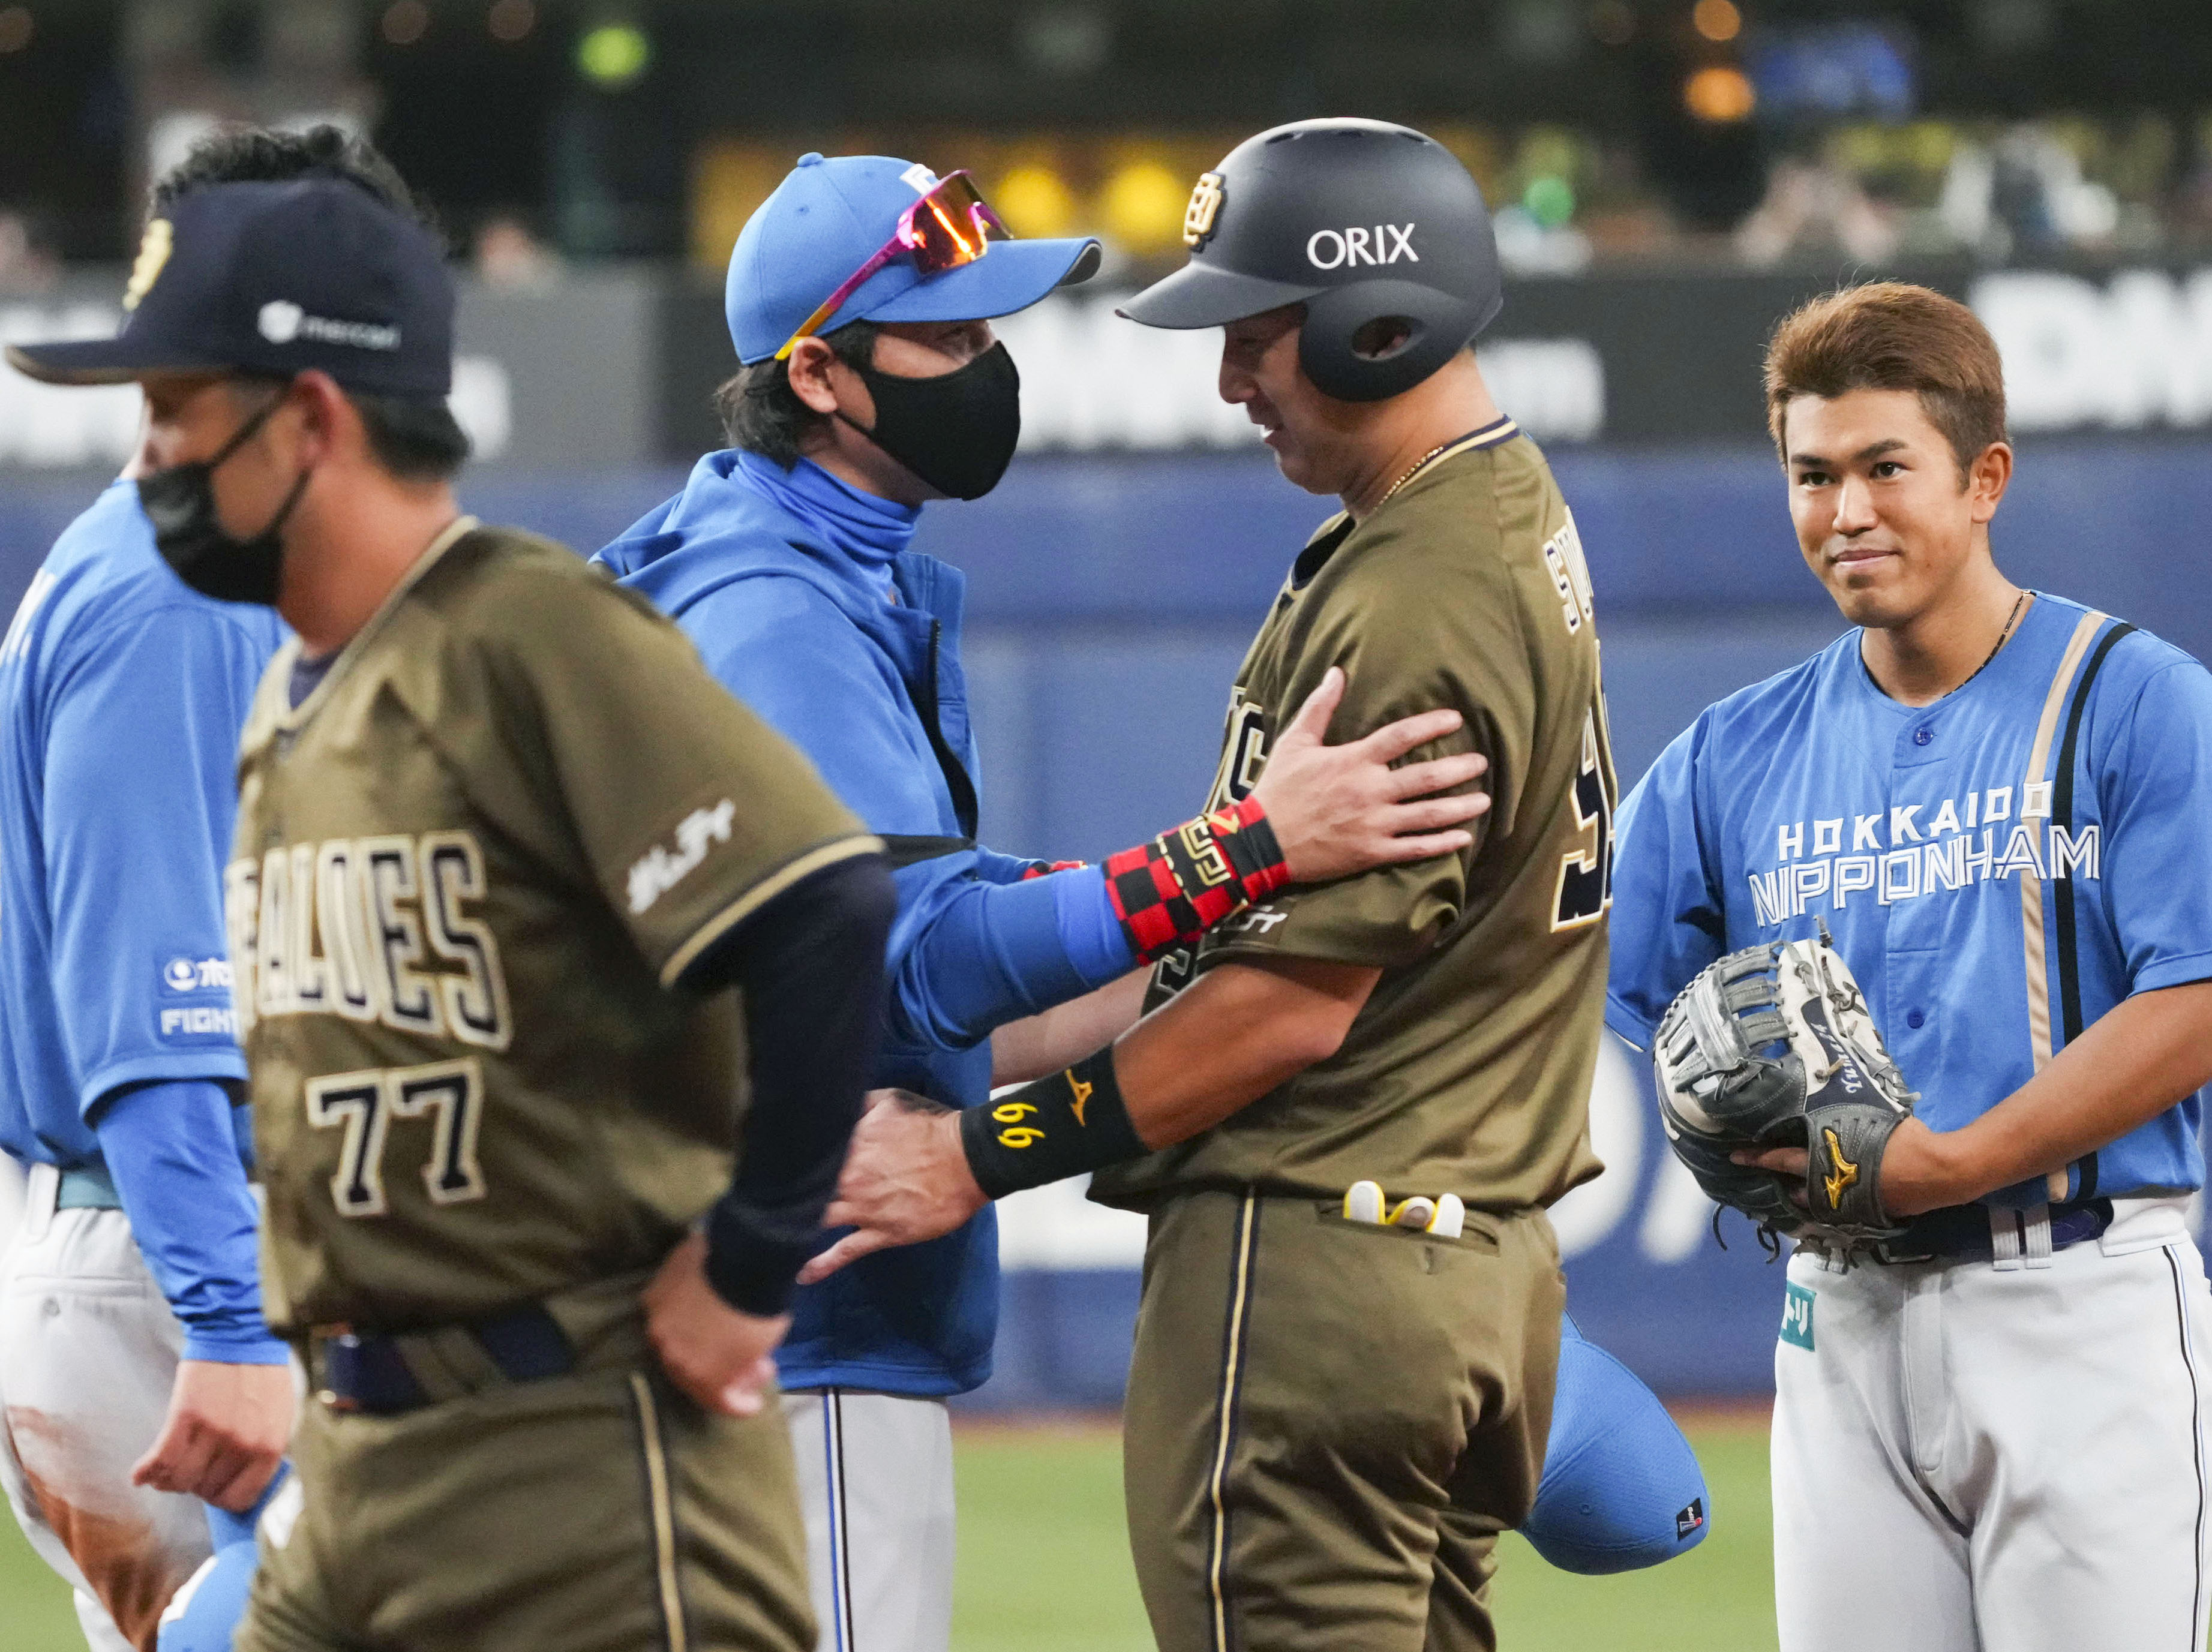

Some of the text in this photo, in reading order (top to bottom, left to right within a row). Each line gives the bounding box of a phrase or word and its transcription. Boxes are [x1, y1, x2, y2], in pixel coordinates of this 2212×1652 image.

[1307, 223, 1419, 270] ORIX
[1778, 780, 2052, 861] HOKKAIDO
[1748, 825, 2100, 927] NIPPONHAM
[306, 1058, 488, 1217] 77
